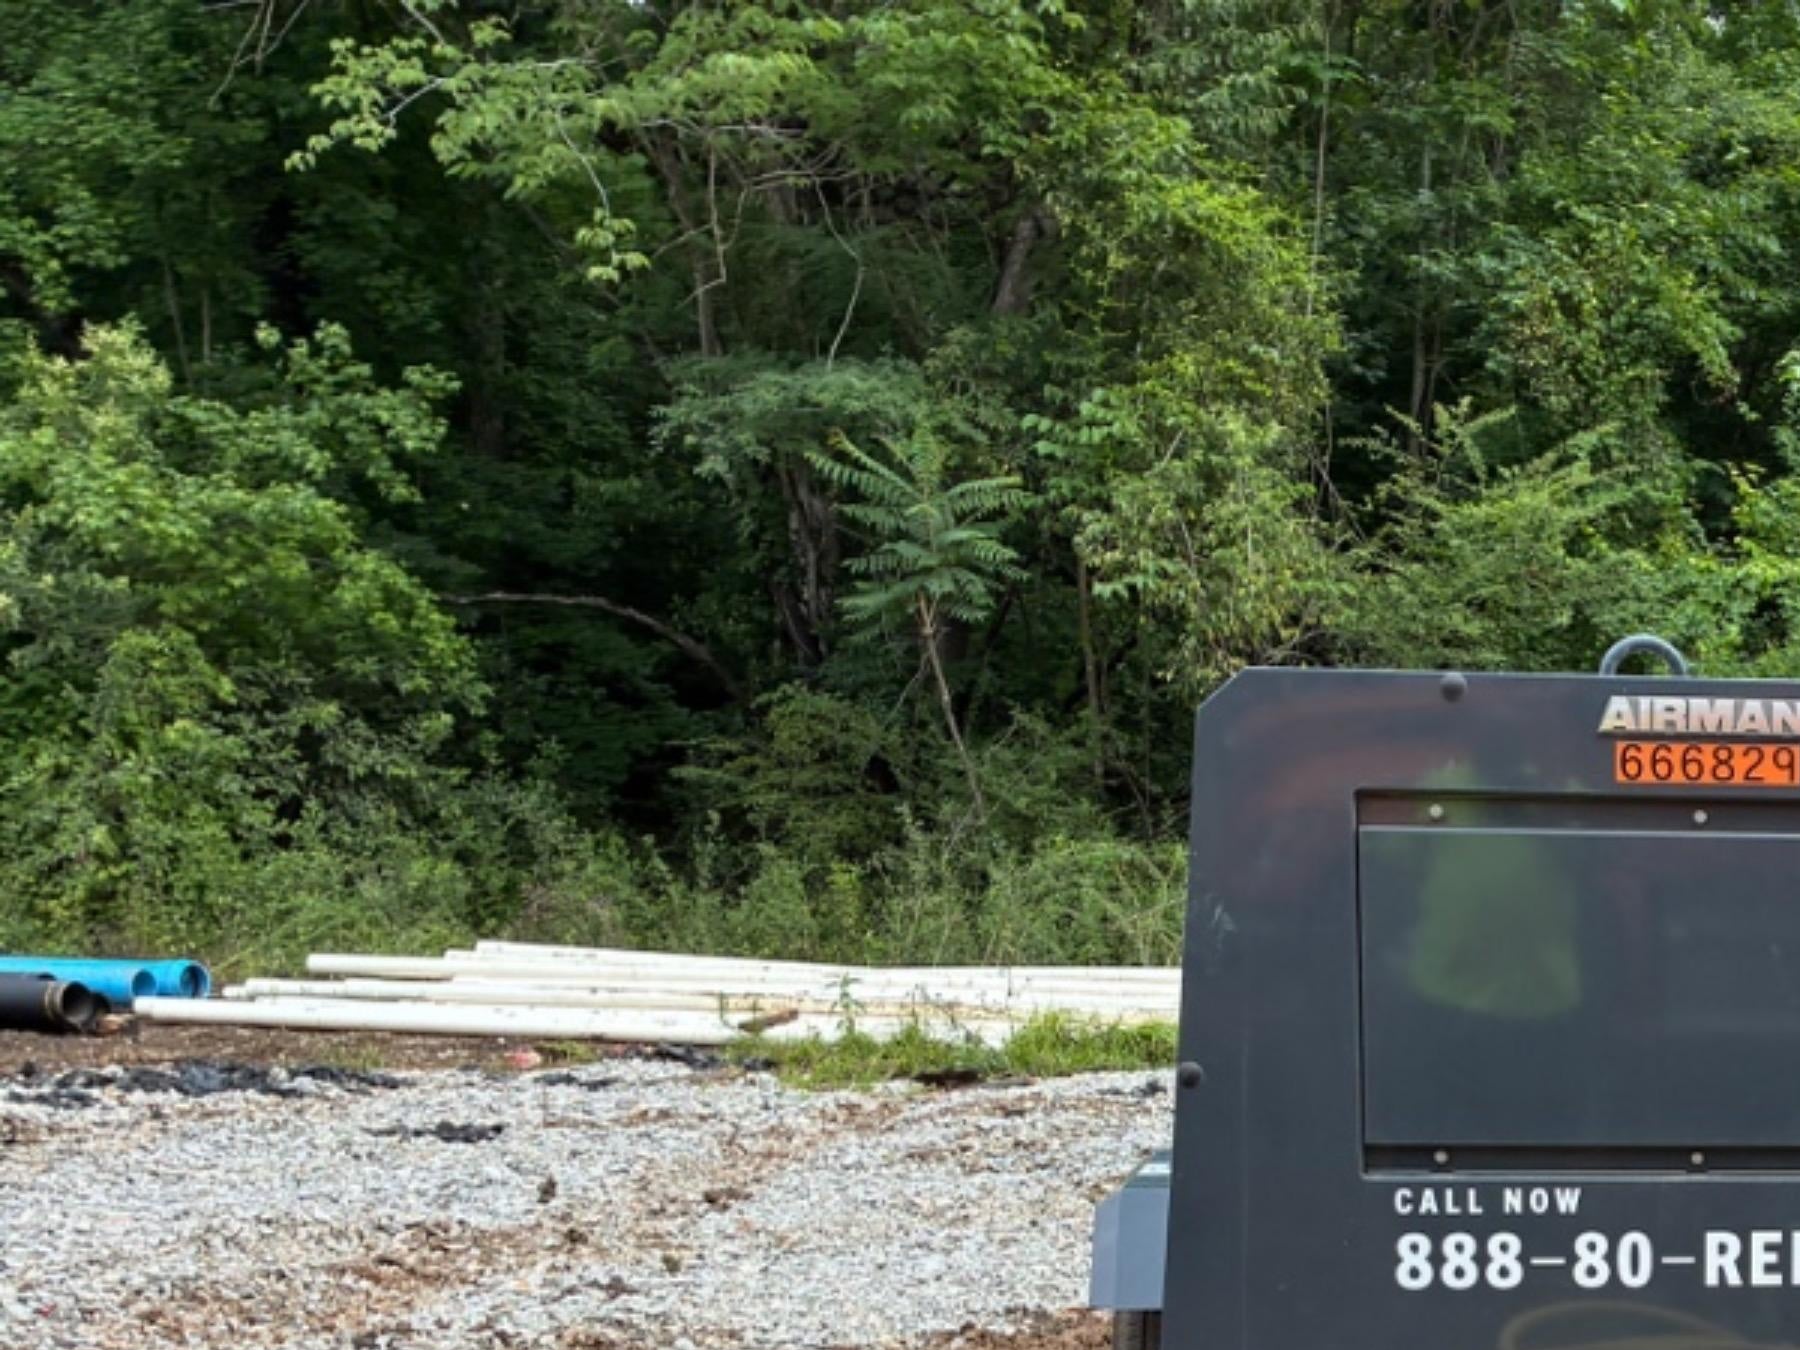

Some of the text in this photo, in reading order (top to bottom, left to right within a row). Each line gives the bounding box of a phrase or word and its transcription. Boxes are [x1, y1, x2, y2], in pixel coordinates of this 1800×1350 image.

[1620, 743, 1796, 782] 666829
[1394, 1187, 1583, 1215] CALL NOW
